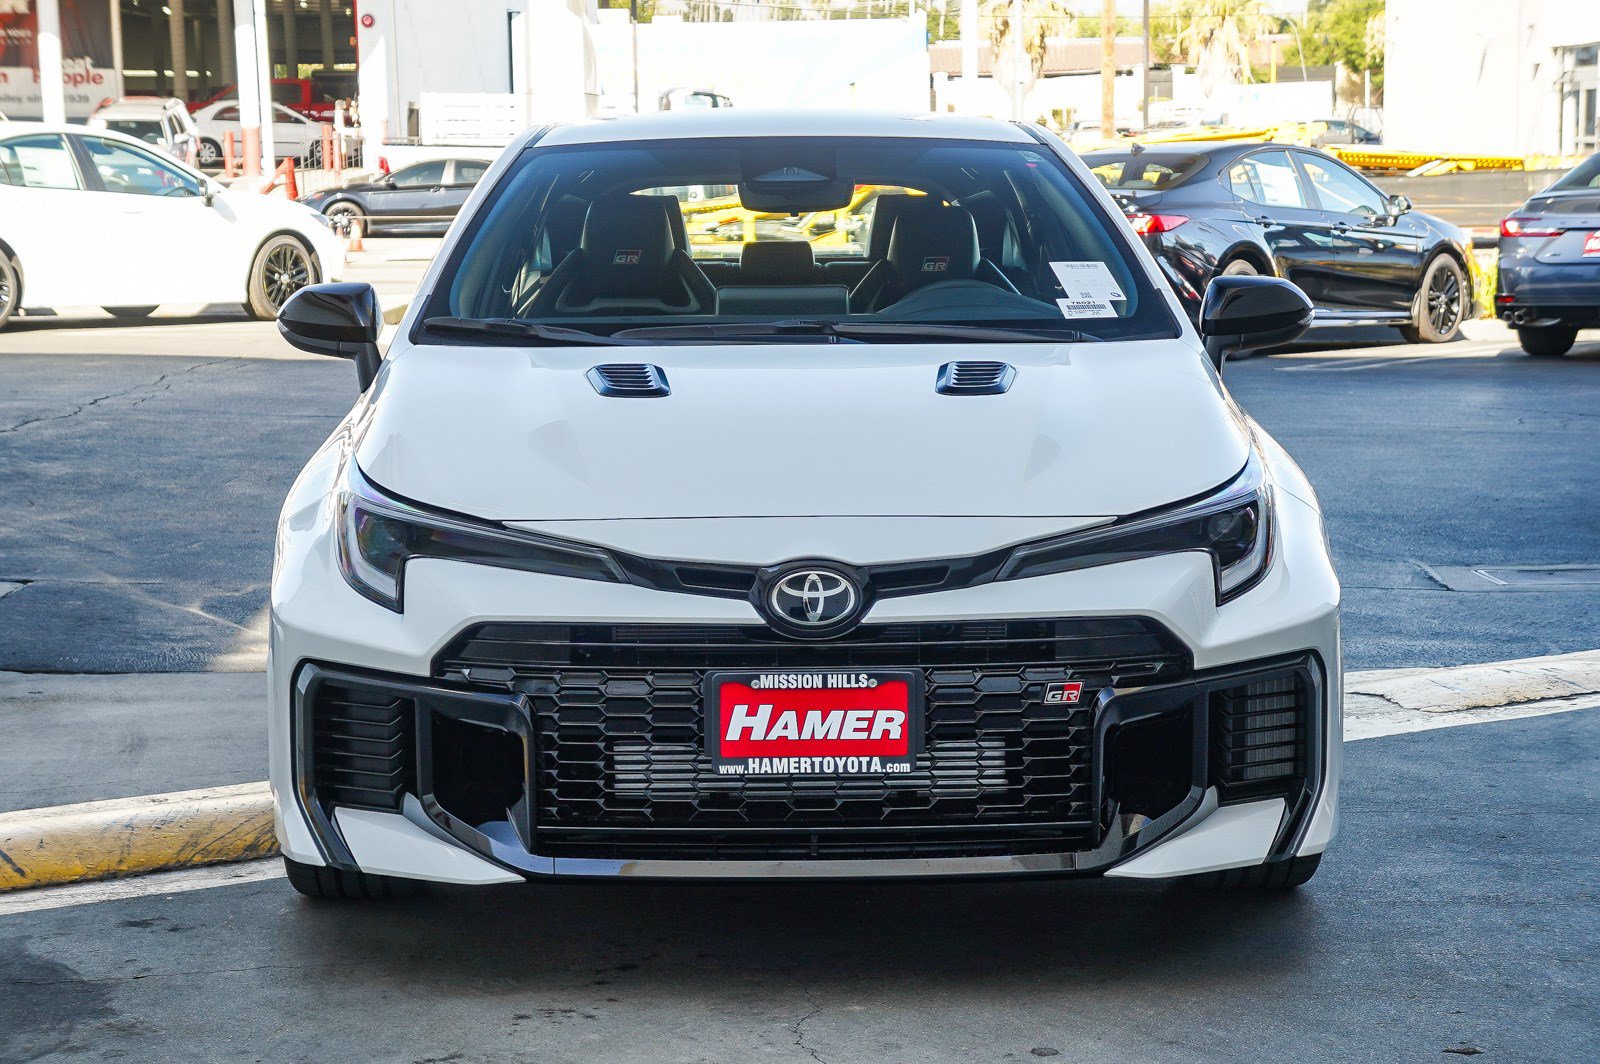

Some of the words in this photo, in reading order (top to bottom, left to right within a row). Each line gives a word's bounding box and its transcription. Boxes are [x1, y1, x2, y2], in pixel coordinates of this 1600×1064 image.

[759, 674, 822, 689] MISSION
[828, 673, 868, 688] HILLS
[1046, 690, 1079, 702] GR
[725, 704, 906, 741] HAMER
[719, 756, 911, 775] www.HAMERTOYOTA.com
